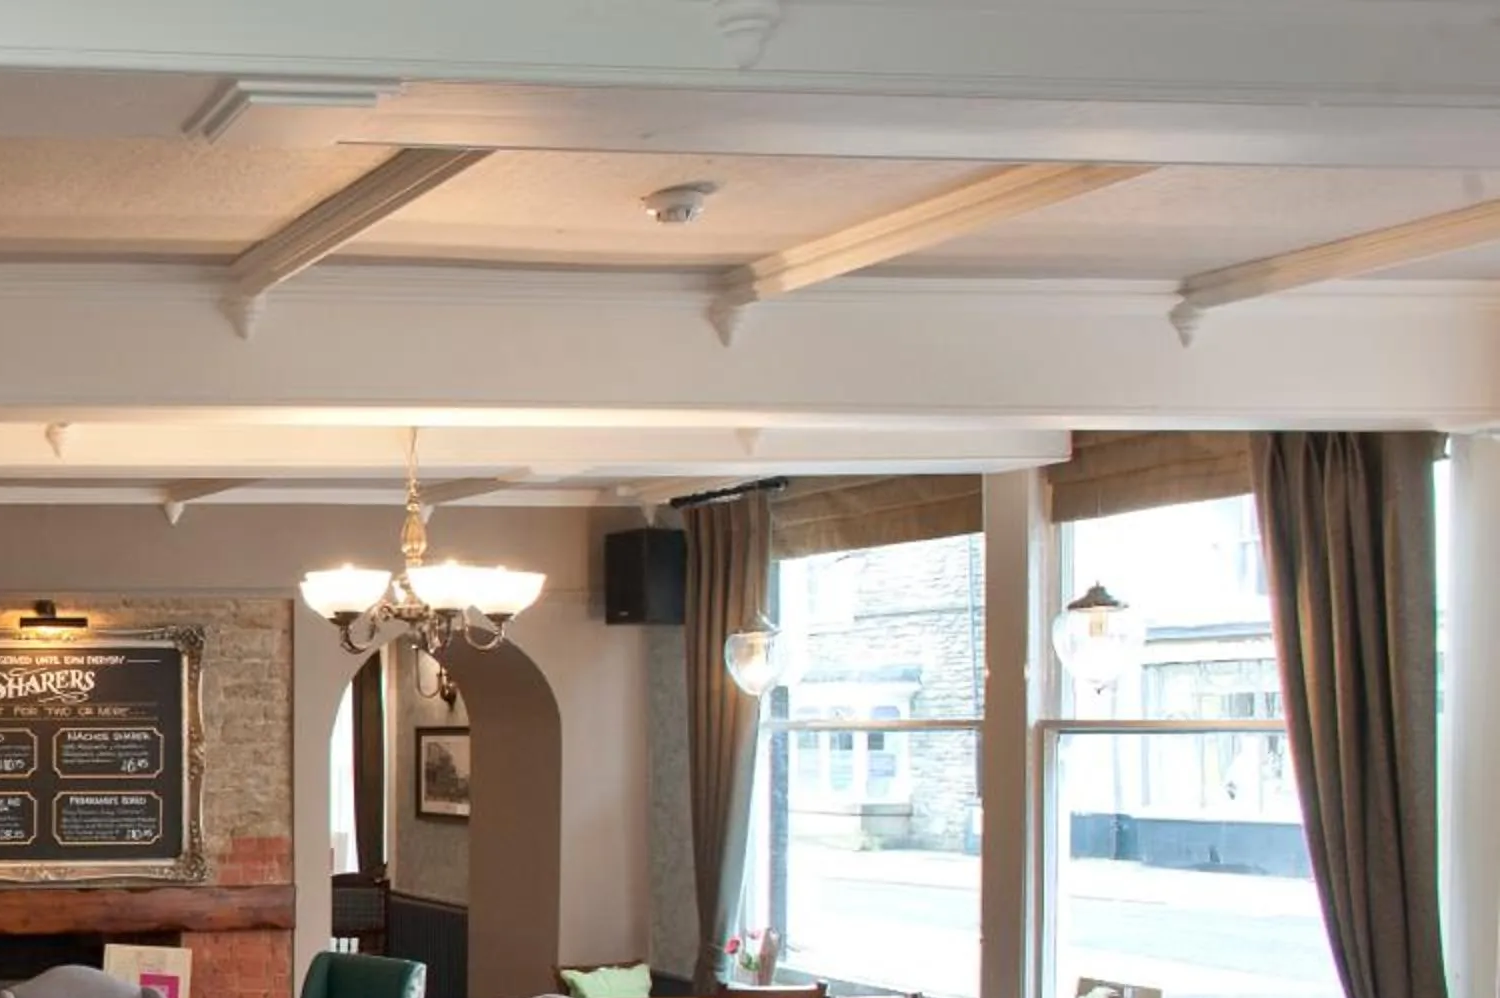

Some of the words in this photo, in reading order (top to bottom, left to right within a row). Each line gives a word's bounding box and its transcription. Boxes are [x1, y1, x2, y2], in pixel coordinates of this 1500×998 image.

[14, 706, 39, 716] FOR
[45, 706, 71, 716] TWO
[78, 706, 94, 716] OR
